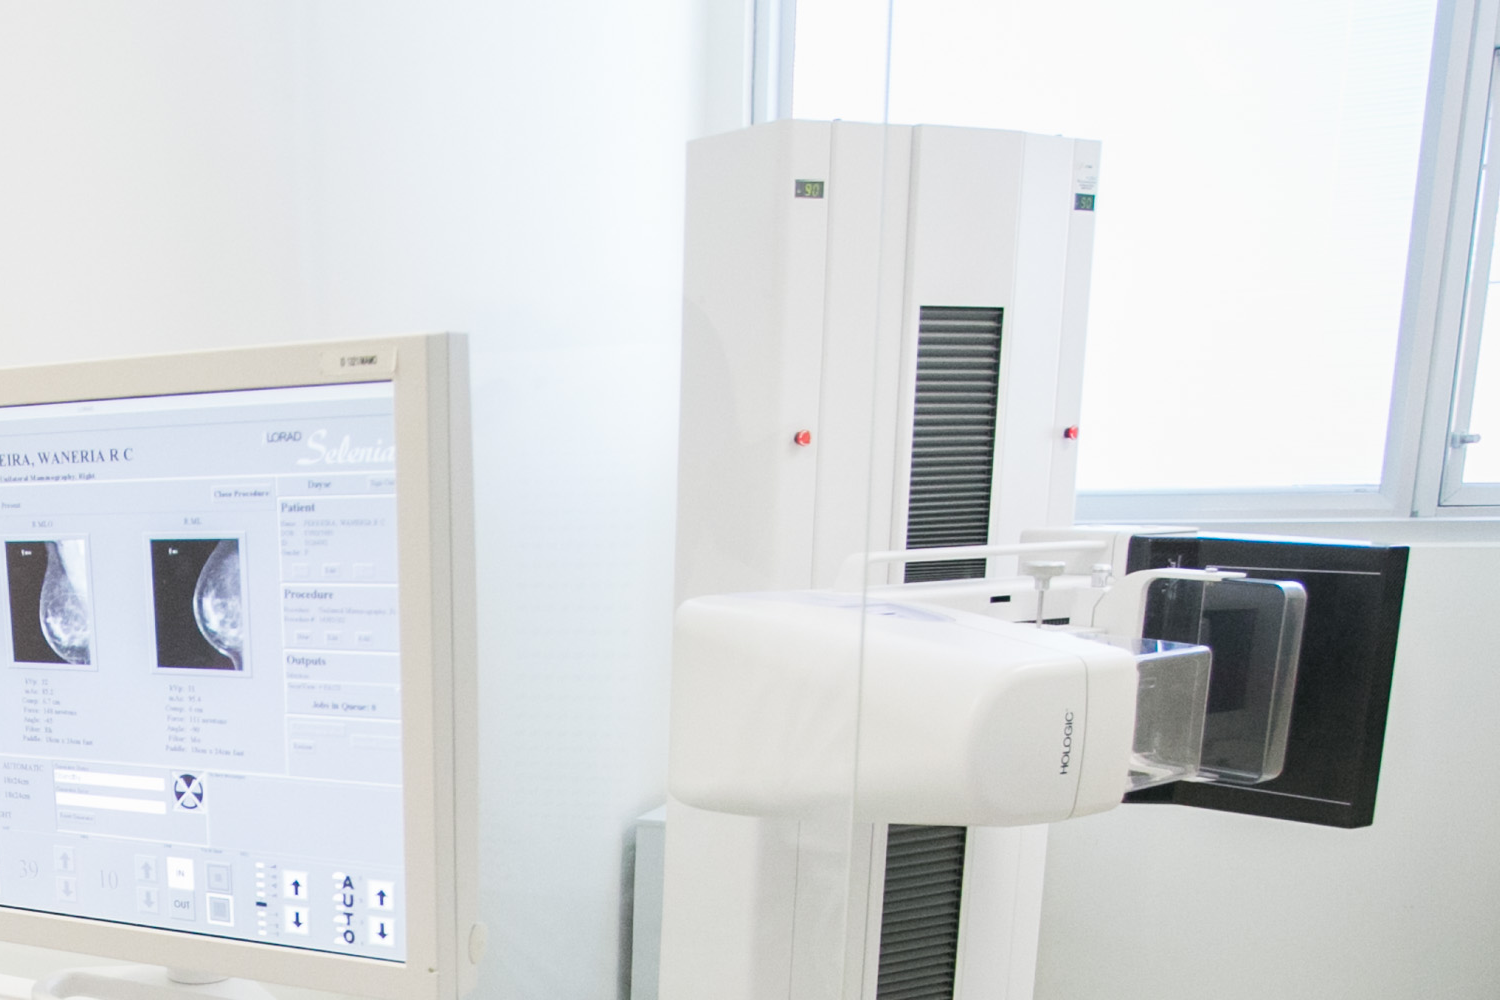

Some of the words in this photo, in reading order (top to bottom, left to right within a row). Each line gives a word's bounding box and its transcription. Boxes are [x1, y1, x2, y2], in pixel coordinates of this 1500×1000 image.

[266, 431, 302, 444] LORAD
[296, 428, 396, 466] Selenia
[37, 449, 106, 465] WANERIA
[109, 448, 120, 462] R
[123, 448, 134, 462] C
[281, 501, 316, 513] Patient
[284, 589, 334, 600] Procedure
[286, 655, 326, 668] Outputs
[1060, 711, 1074, 775] HOLOGIC
[19, 859, 39, 879] 39
[99, 869, 119, 890] 10
[173, 899, 190, 910] OUT
[342, 875, 356, 945] AUTO
